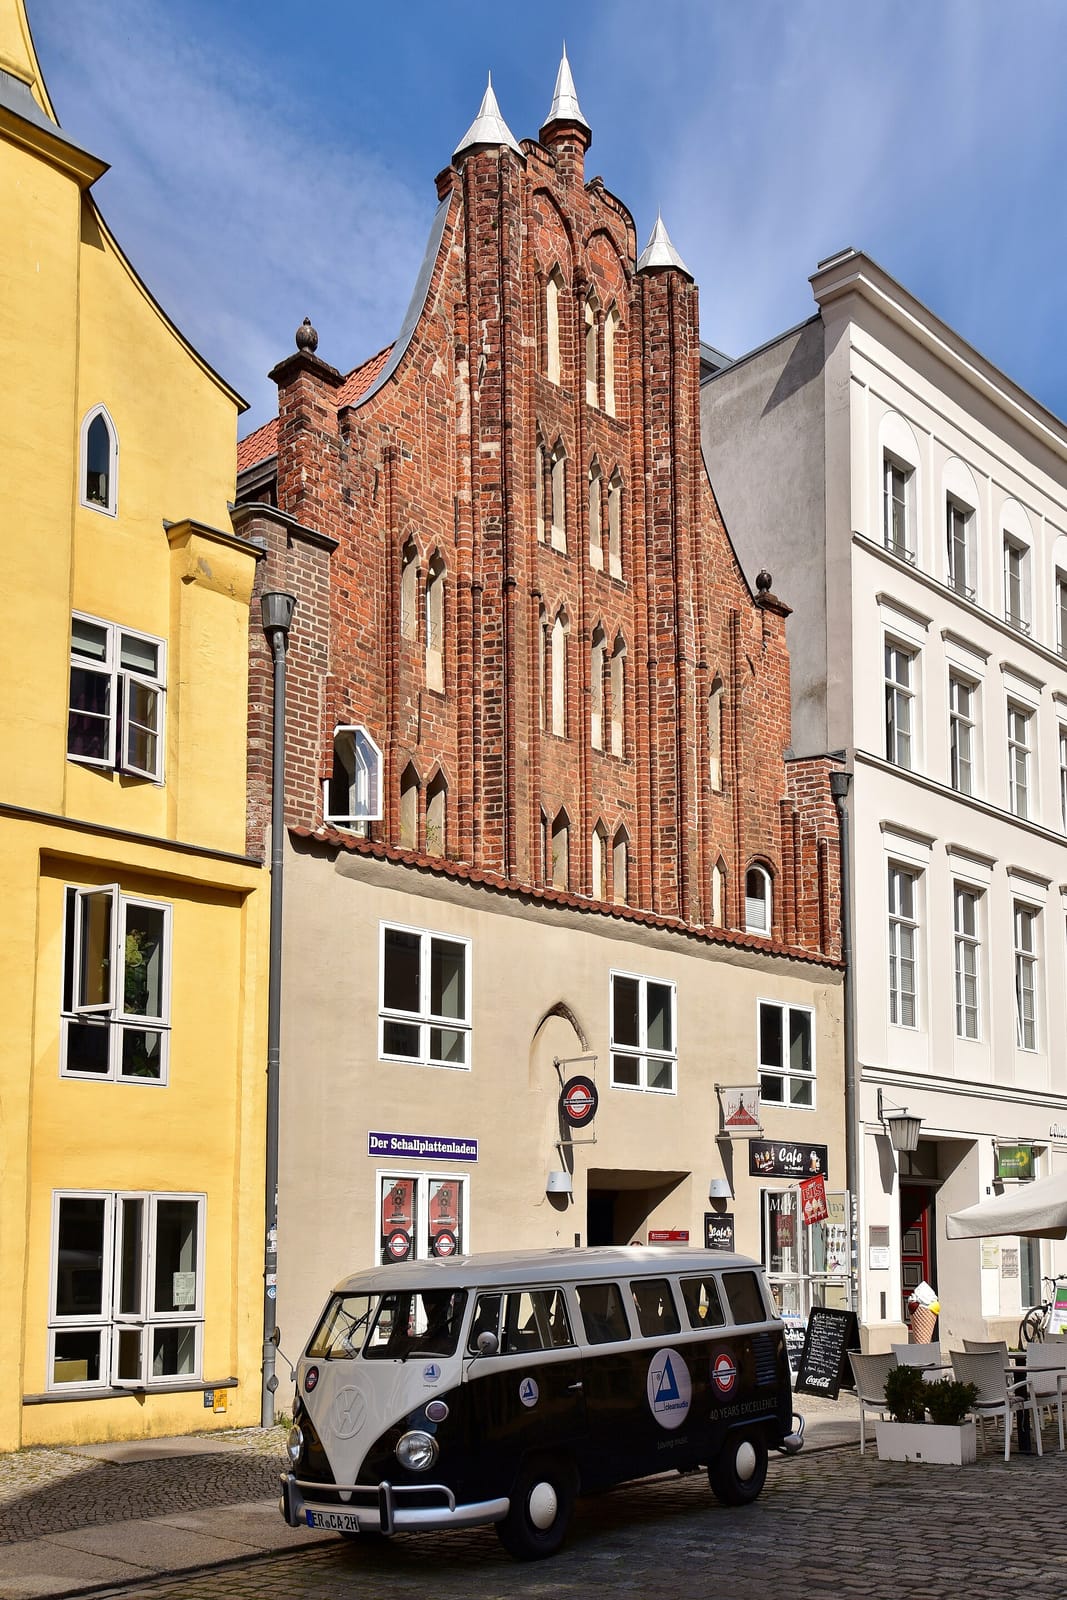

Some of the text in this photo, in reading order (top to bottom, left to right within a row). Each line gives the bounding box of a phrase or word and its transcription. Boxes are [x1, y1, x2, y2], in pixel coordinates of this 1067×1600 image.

[371, 1136, 476, 1154] Der Schallplattenladen
[778, 1147, 802, 1166] Cafe
[709, 1397, 778, 1420] 40 YEARS EXCELLENCE
[311, 1512, 358, 1530] ER CA 2H
